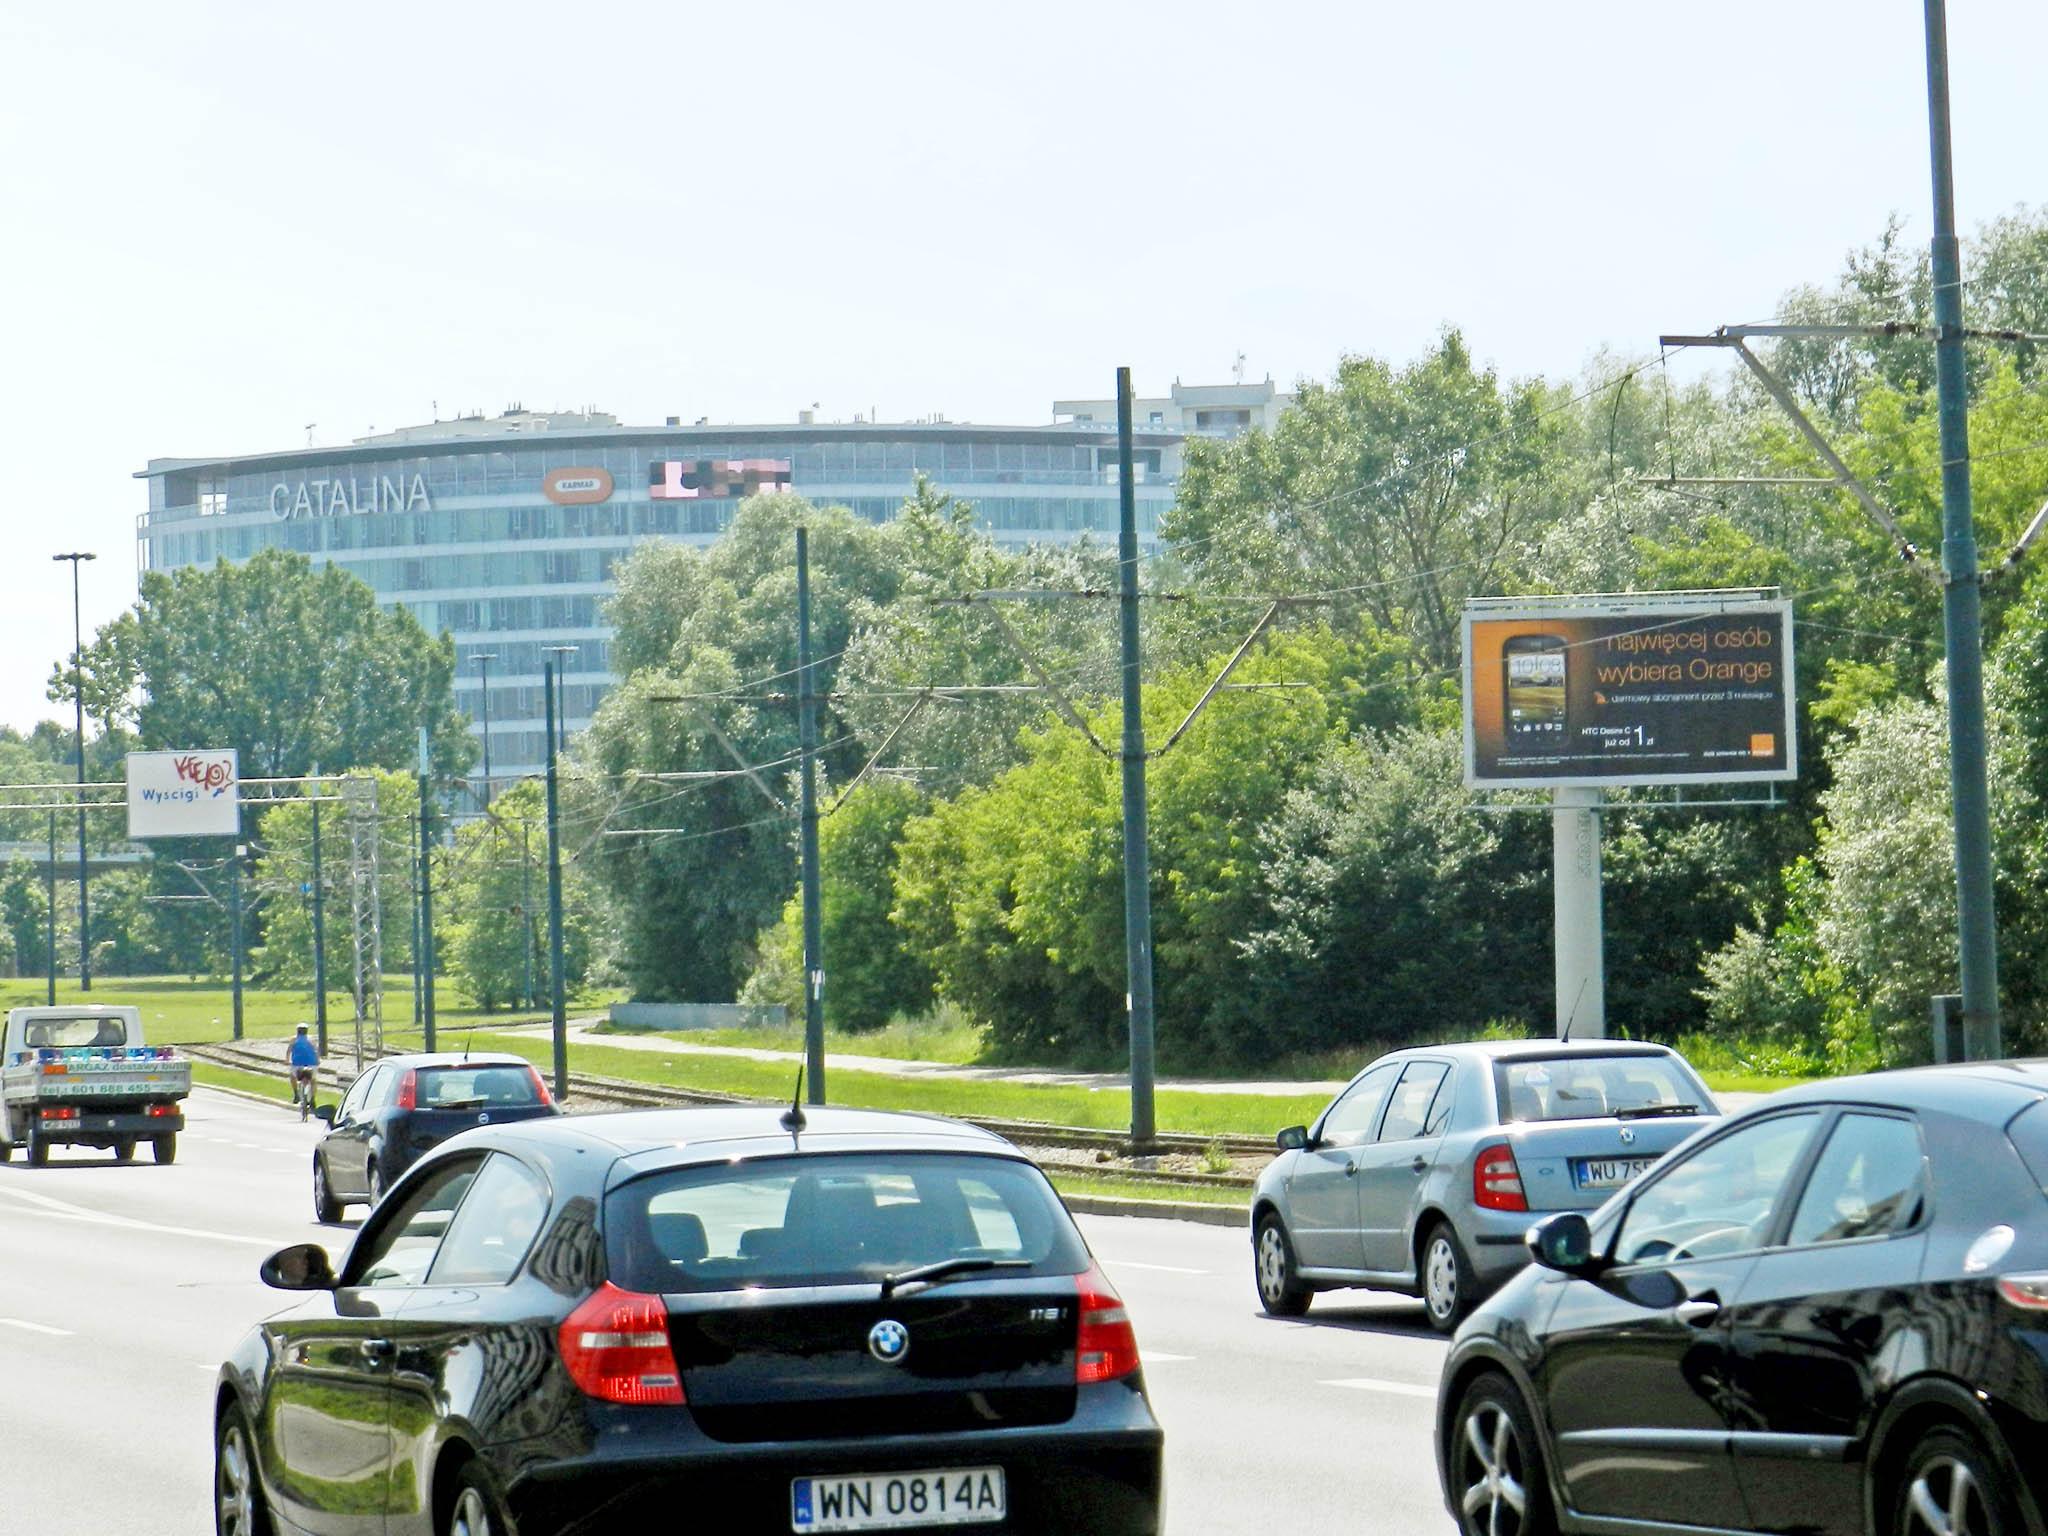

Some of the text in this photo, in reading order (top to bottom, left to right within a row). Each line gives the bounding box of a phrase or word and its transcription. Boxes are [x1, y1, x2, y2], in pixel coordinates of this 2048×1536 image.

[270, 473, 432, 521] CATALINA
[1607, 626, 1772, 654] najwięcej osób
[1599, 658, 1772, 687] wybiera Orange
[1581, 727, 1598, 736] HTC
[1624, 726, 1631, 735] C
[1618, 737, 1630, 746] od
[1634, 724, 1643, 746] 1
[112, 1061, 158, 1073] dostawy
[1591, 1162, 1616, 1181] WU
[818, 1473, 996, 1519] WN 0814A
